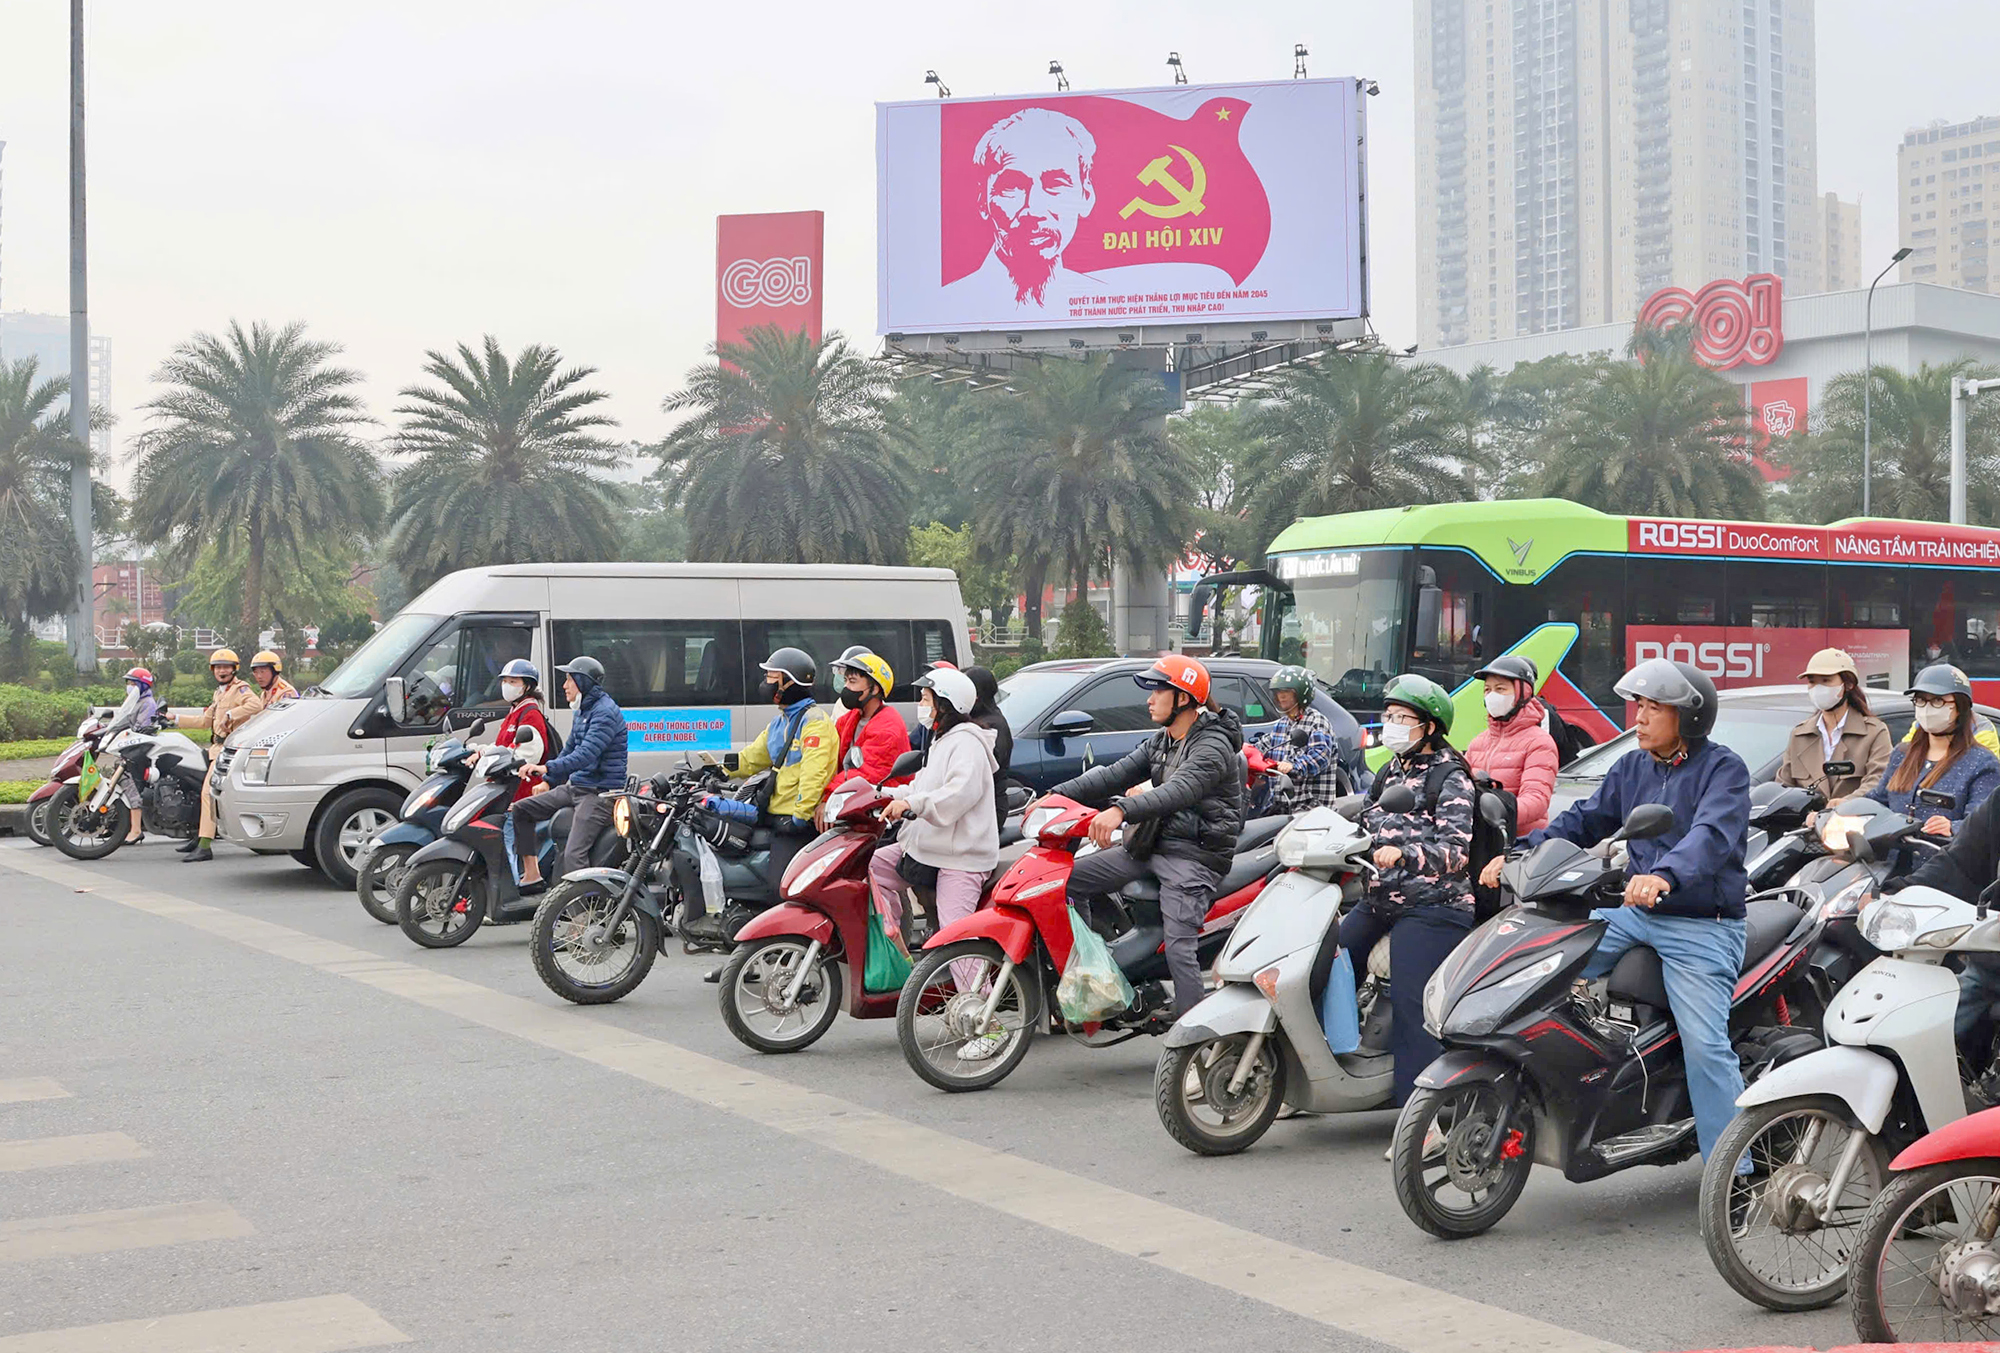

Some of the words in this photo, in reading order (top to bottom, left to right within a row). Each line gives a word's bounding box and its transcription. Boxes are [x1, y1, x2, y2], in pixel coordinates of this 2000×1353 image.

[1102, 231, 1138, 253] ĐẠI
[1145, 225, 1182, 251] HỘI
[1188, 227, 1224, 246] XIV
[721, 256, 812, 309] GO!
[1069, 296, 1090, 306] QUYẾT
[1092, 296, 1106, 305] TÂM
[1108, 295, 1126, 304] THỰC
[1127, 294, 1144, 304] HIỆN
[1145, 293, 1168, 303] THẮNG
[1169, 293, 1180, 302] LỢI
[1182, 292, 1198, 302] MỤC
[1200, 291, 1215, 300] TIÊU
[1216, 290, 1231, 300] ĐẾN
[1232, 290, 1250, 299] NĂM
[1250, 290, 1268, 298] 2045
[1069, 307, 1083, 317] TRỞ
[1084, 306, 1106, 316] THÀNH
[1108, 306, 1128, 315] NƯỚC
[1128, 305, 1146, 314] PHÁT
[1148, 304, 1170, 314] TRIỂN,
[1172, 304, 1186, 313] THU
[1186, 303, 1206, 313] NHẬP
[1208, 302, 1224, 312] CAO!
[1729, 532, 1820, 552] DuoComfort
[1835, 534, 1880, 555] NÂNG
[1882, 534, 1916, 556] TẦM
[1918, 537, 1950, 558] TRẢI
[1506, 568, 1536, 576] VINBUS
[626, 719, 647, 730] ƯỜNG
[644, 732, 672, 742] ALFRED
[673, 732, 697, 742] NOBEL
